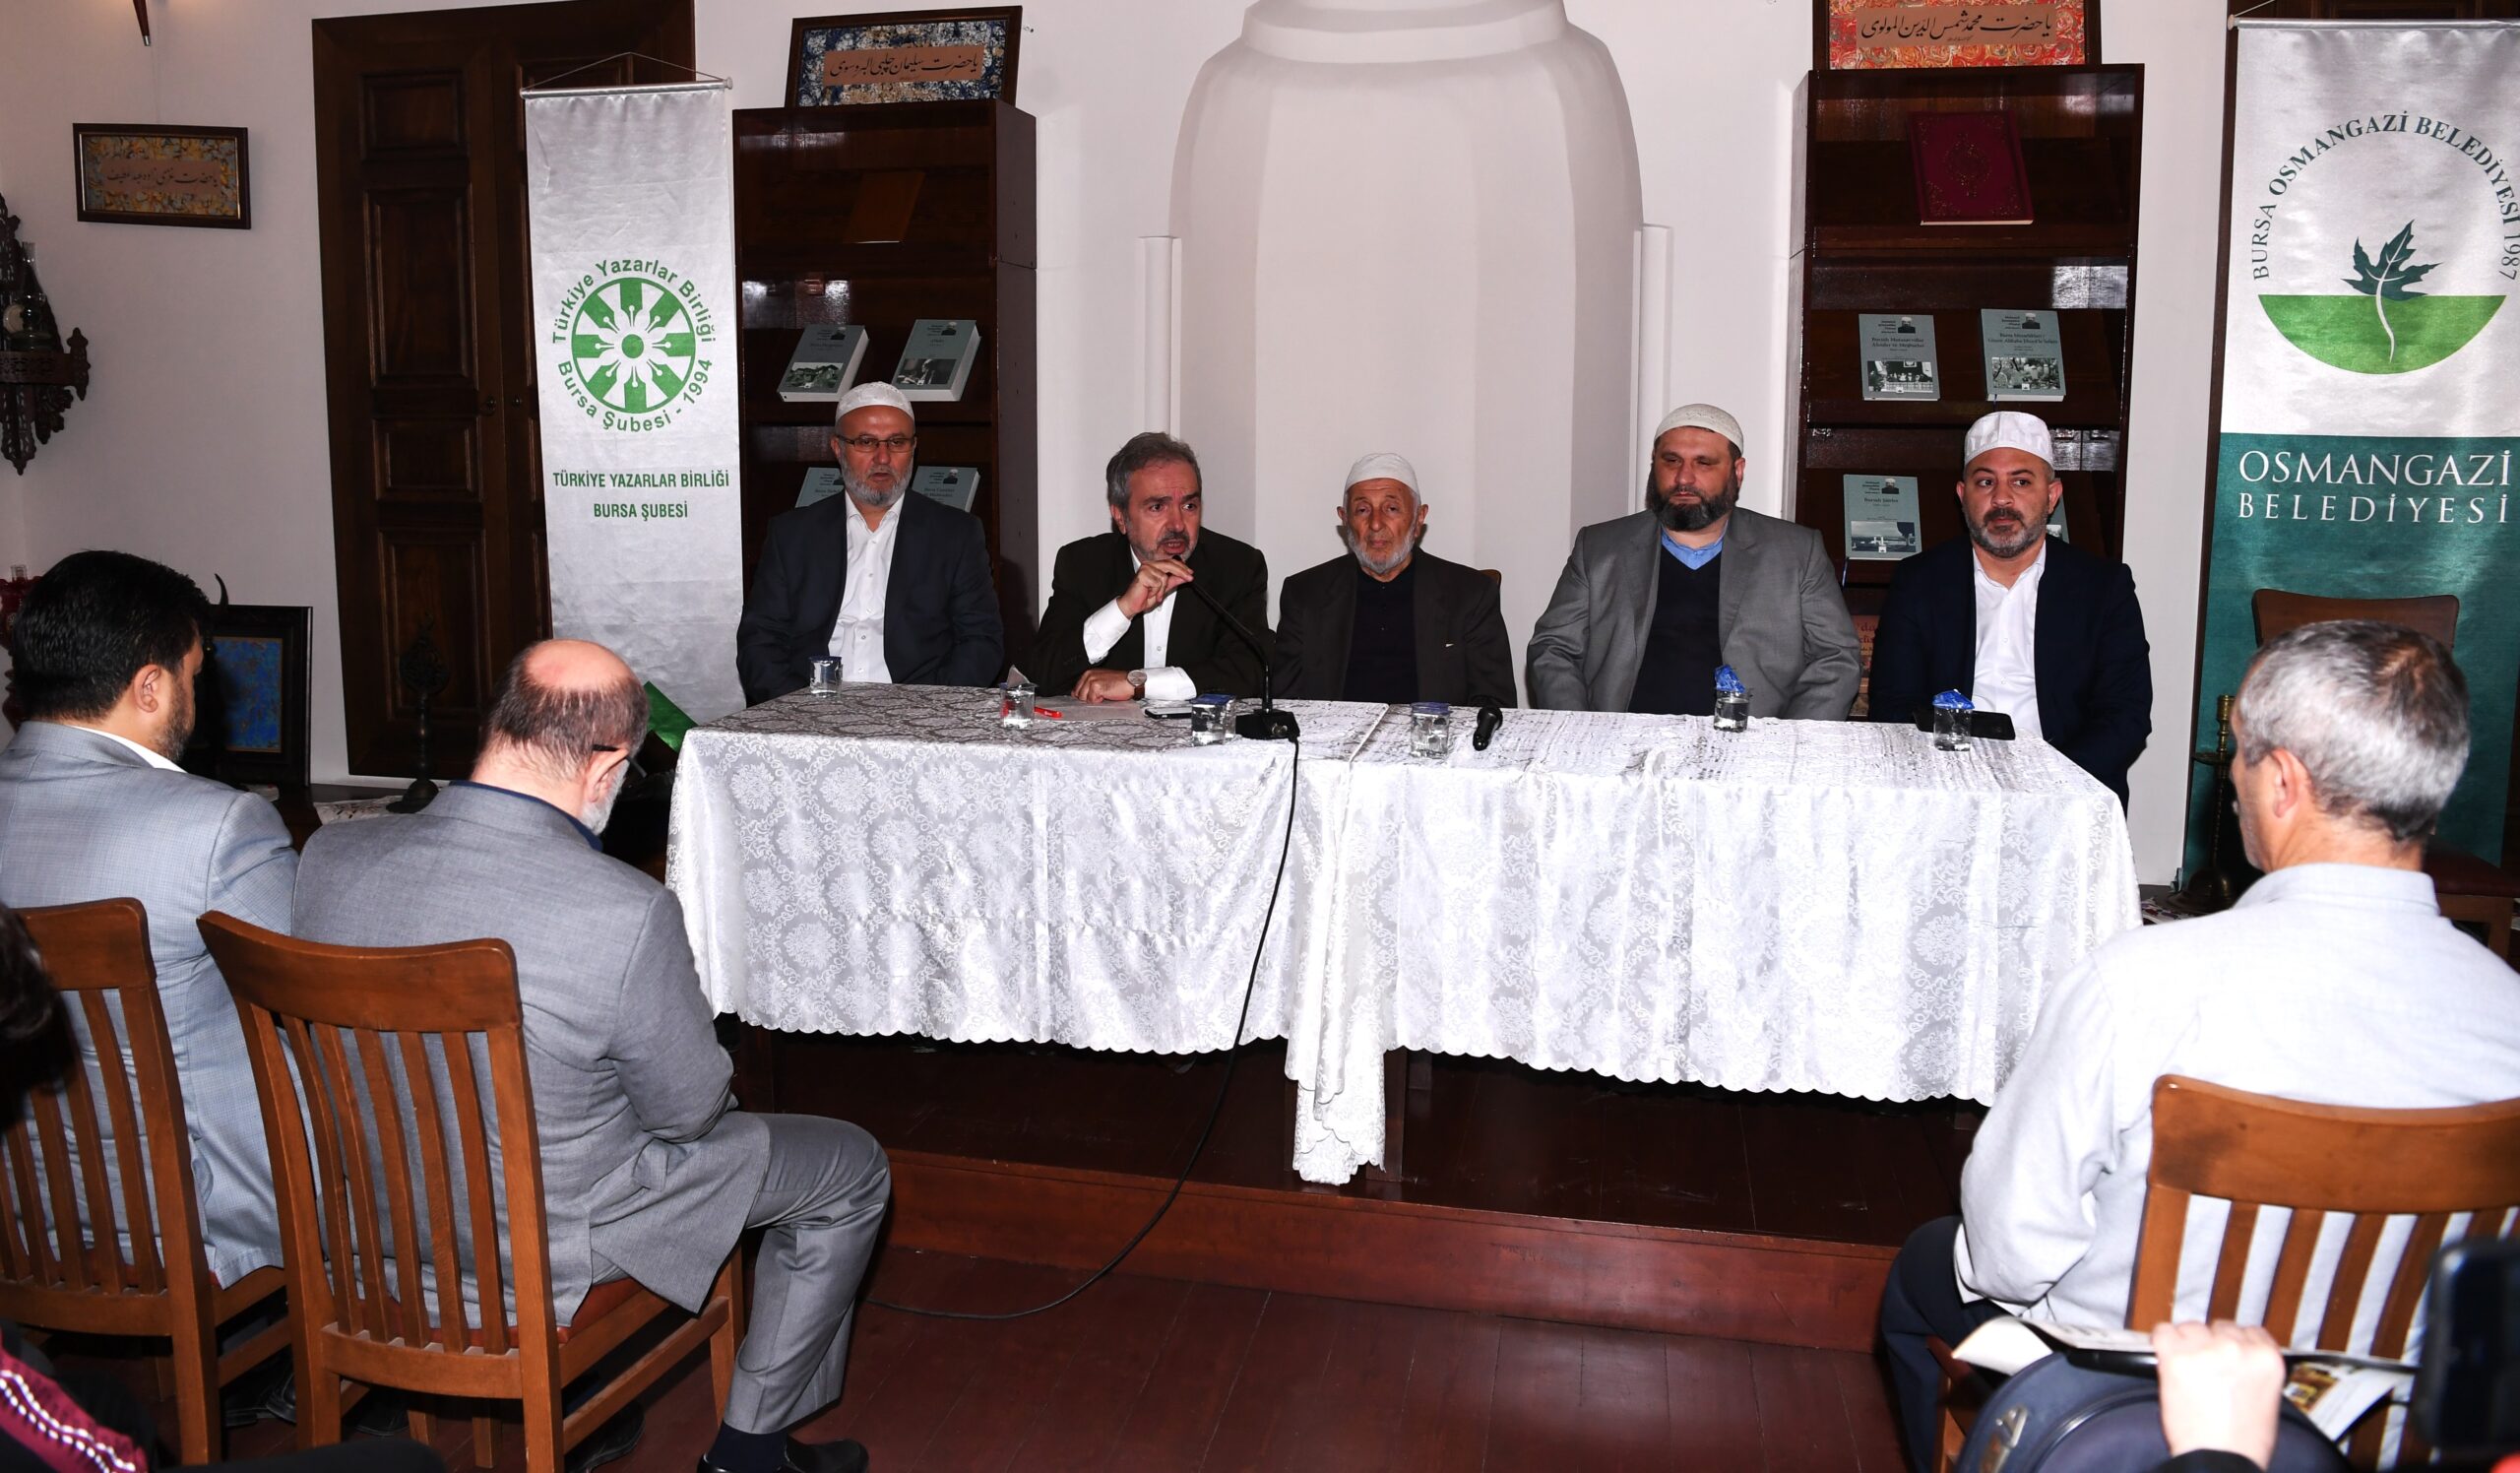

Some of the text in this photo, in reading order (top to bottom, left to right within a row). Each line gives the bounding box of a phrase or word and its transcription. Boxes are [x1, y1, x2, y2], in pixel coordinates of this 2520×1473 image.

[2251, 204, 2278, 281] BURSA
[2268, 110, 2409, 196] OSMANGAZİ
[2499, 234, 2520, 280] 1987
[553, 259, 716, 344] Türkiye Yazarlar Birliği
[558, 360, 597, 417] Bursa
[602, 410, 671, 432] Şubesi
[683, 359, 713, 405] 1994
[553, 470, 729, 487] TÜRKİYE YAZARLAR BİRLİĞİ
[2239, 449, 2512, 486] OSMANGAZİ
[594, 500, 688, 521] BURSA ŞUBESİ
[2237, 492, 2509, 524] BELEDİYESİ
